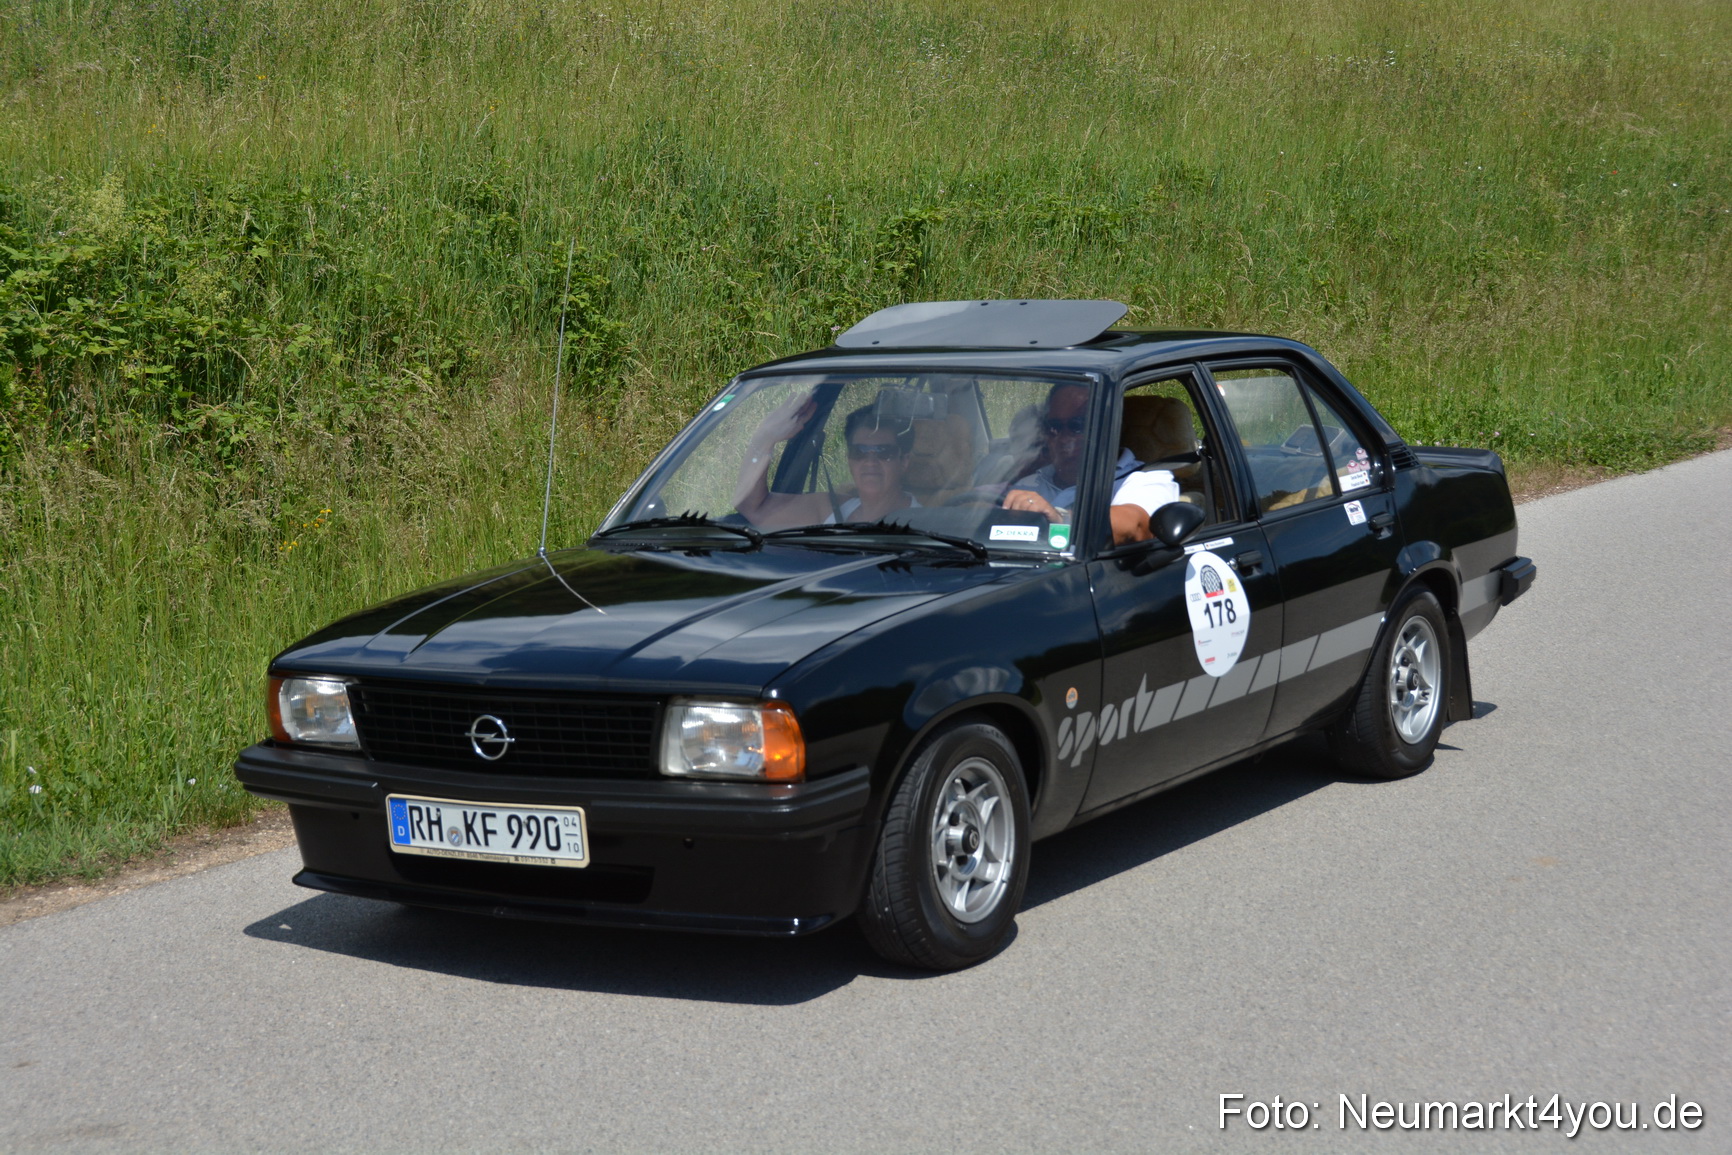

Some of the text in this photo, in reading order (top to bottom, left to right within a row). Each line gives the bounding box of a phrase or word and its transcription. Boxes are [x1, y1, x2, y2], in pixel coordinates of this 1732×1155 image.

[1204, 598, 1236, 629] 178
[1057, 672, 1153, 767] sport
[398, 825, 405, 837] D
[408, 805, 561, 851] RH KF 990
[563, 816, 577, 828] 04
[567, 842, 580, 853] 10
